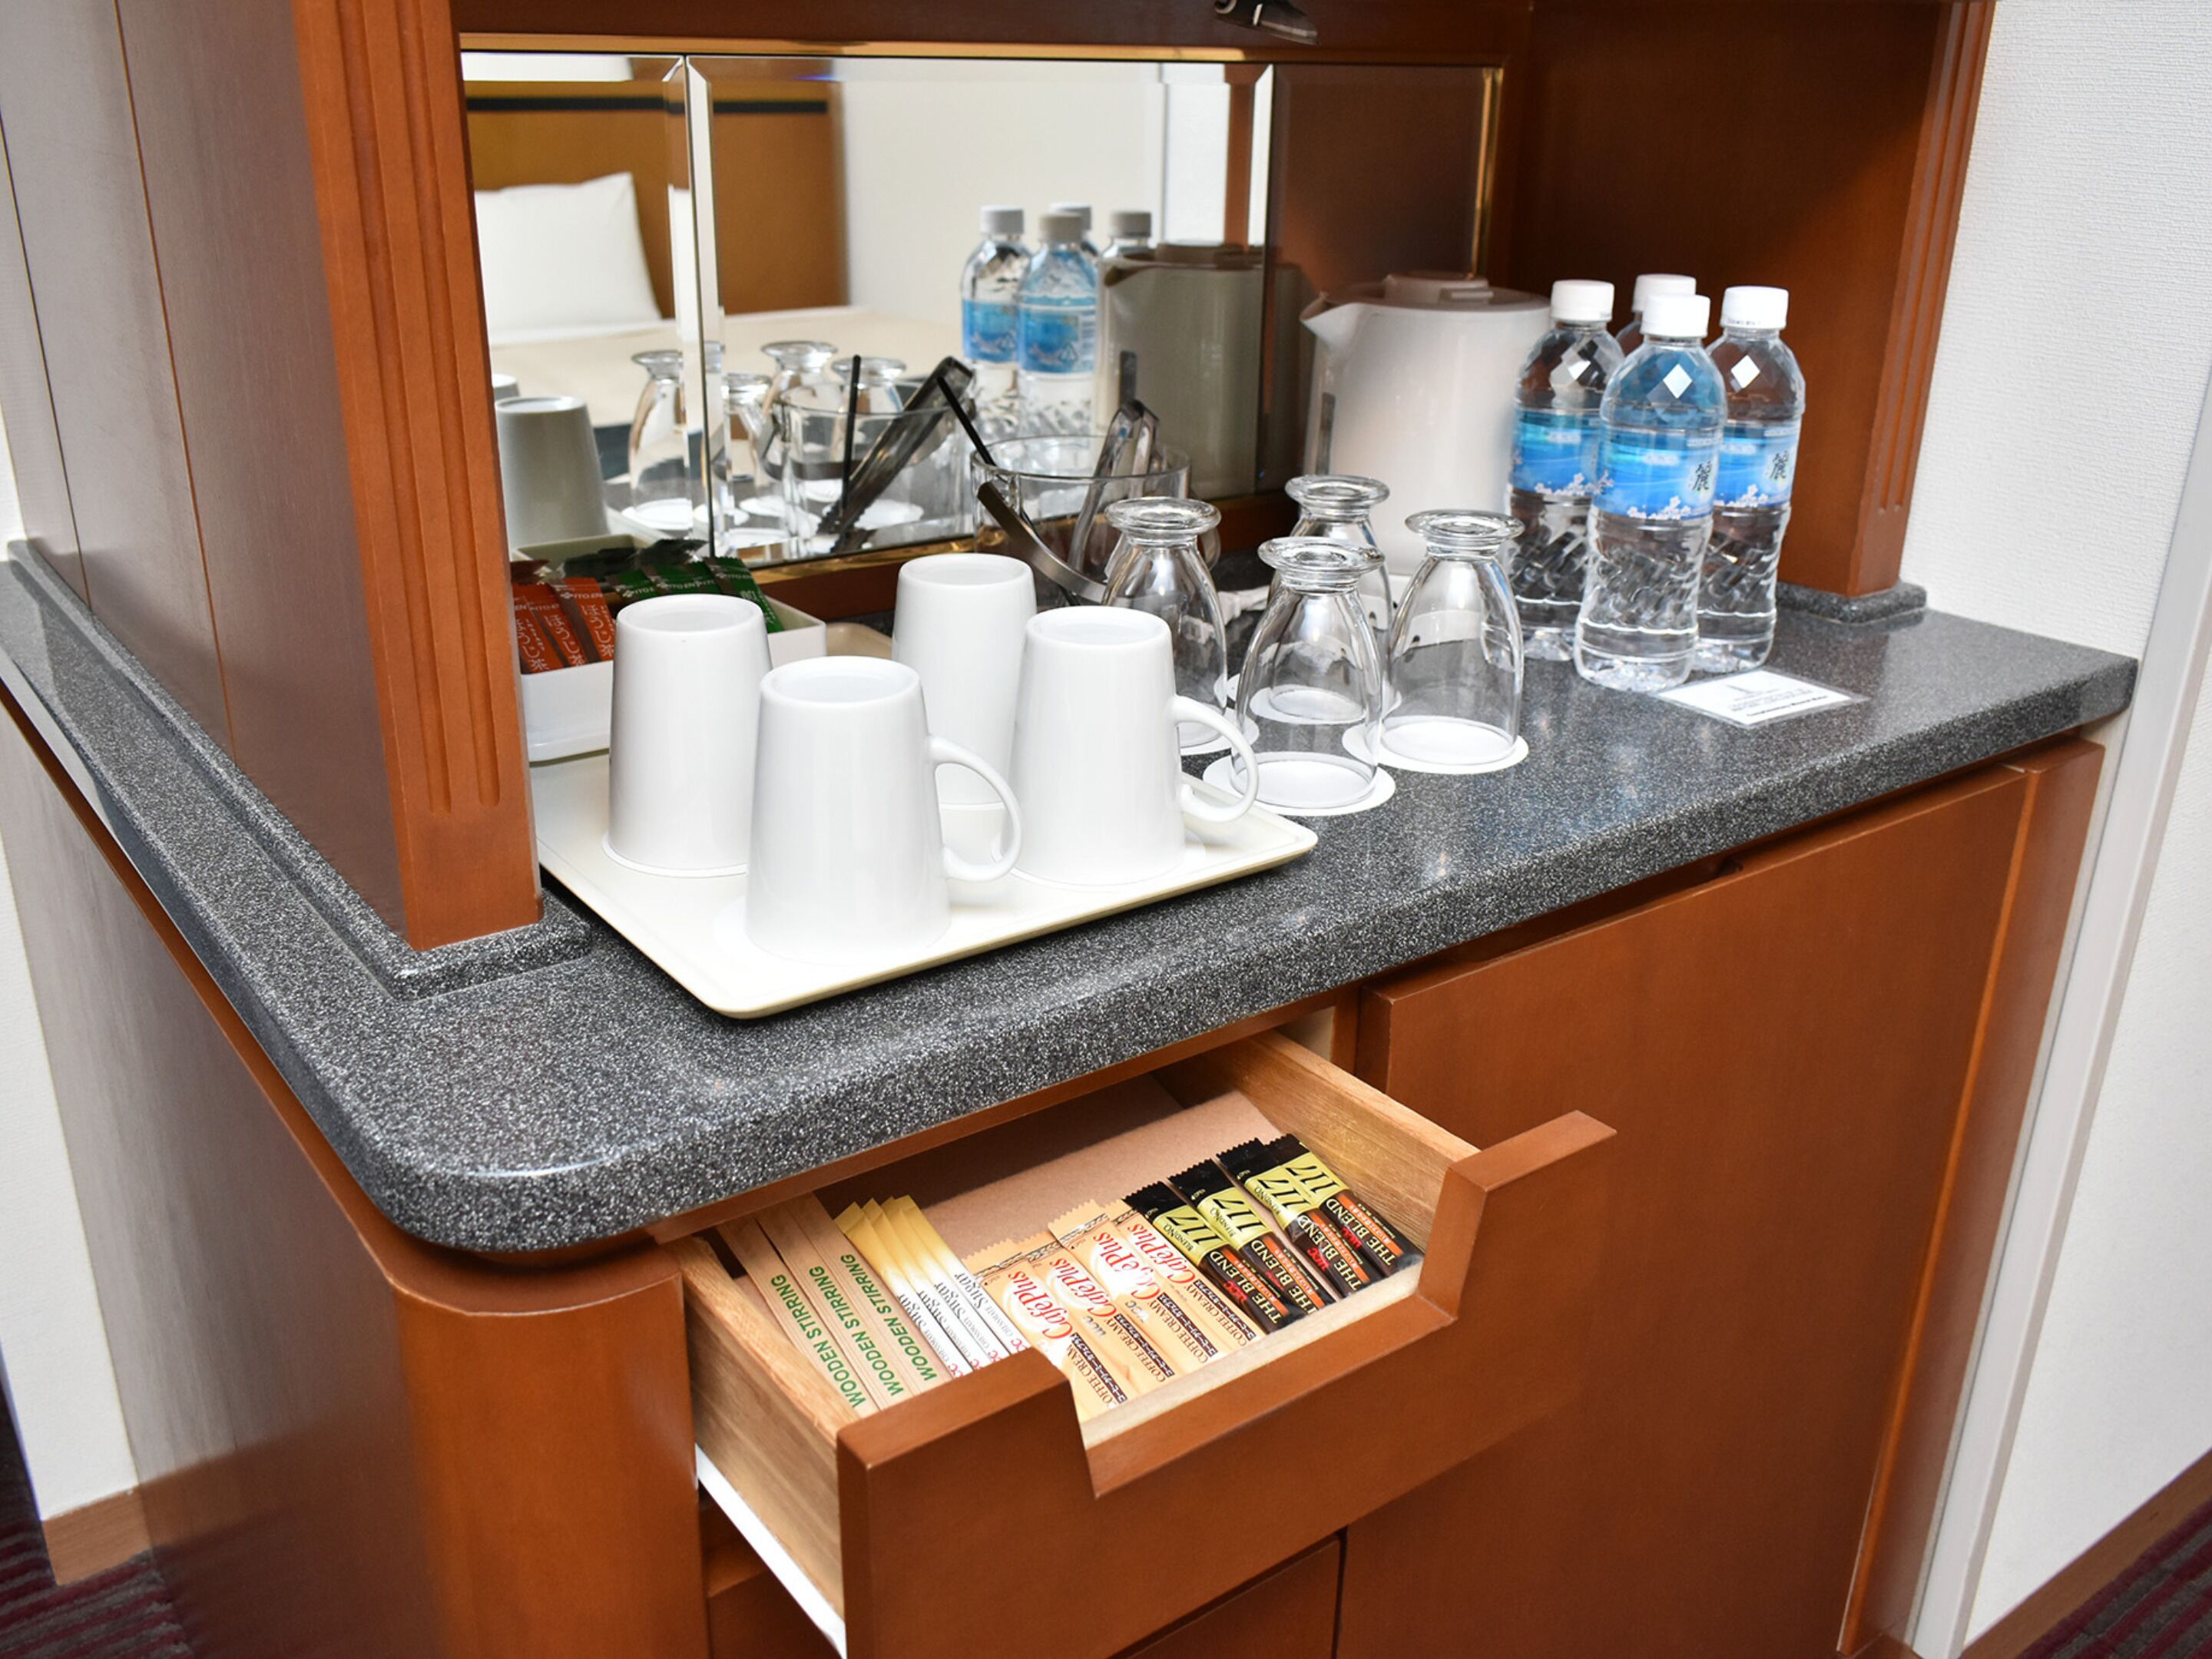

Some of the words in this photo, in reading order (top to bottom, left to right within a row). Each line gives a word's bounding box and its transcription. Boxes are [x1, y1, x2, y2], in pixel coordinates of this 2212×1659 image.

[545, 615, 585, 666] ほうじ茶
[581, 604, 614, 657] ほうじ茶
[1257, 1179, 1311, 1209] 117
[1286, 1165, 1339, 1194] 117
[1166, 1216, 1224, 1244] 117
[1213, 1198, 1267, 1232] 117
[1323, 1195, 1369, 1240] BLEND
[1295, 1212, 1339, 1260] BLEND
[1366, 1234, 1396, 1265] THE
[1208, 1248, 1255, 1294] BLEND
[1249, 1237, 1293, 1286] BLEND
[1333, 1257, 1363, 1290] THE
[809, 1266, 860, 1330] STIRRING
[840, 1254, 892, 1314] STIRRING
[934, 1282, 966, 1319] Sugar
[955, 1273, 988, 1310] Sugar
[1184, 1283, 1220, 1317] CREAMY
[1291, 1284, 1319, 1313] THE
[771, 1274, 822, 1339] STIRRING
[897, 1293, 927, 1328] Sugar
[919, 1290, 947, 1326] Sugar
[1147, 1297, 1182, 1333] CREAMY
[1251, 1290, 1283, 1324] THE
[1104, 1316, 1139, 1353] CREAMY
[1177, 1330, 1209, 1364] COFFEE
[1215, 1313, 1248, 1347] COFFEE
[852, 1331, 904, 1396] WOODEN
[884, 1317, 938, 1381] WOODEN
[1063, 1344, 1092, 1377] CREAM
[1134, 1349, 1166, 1384] COFFEE
[813, 1340, 866, 1409] WOODEN
